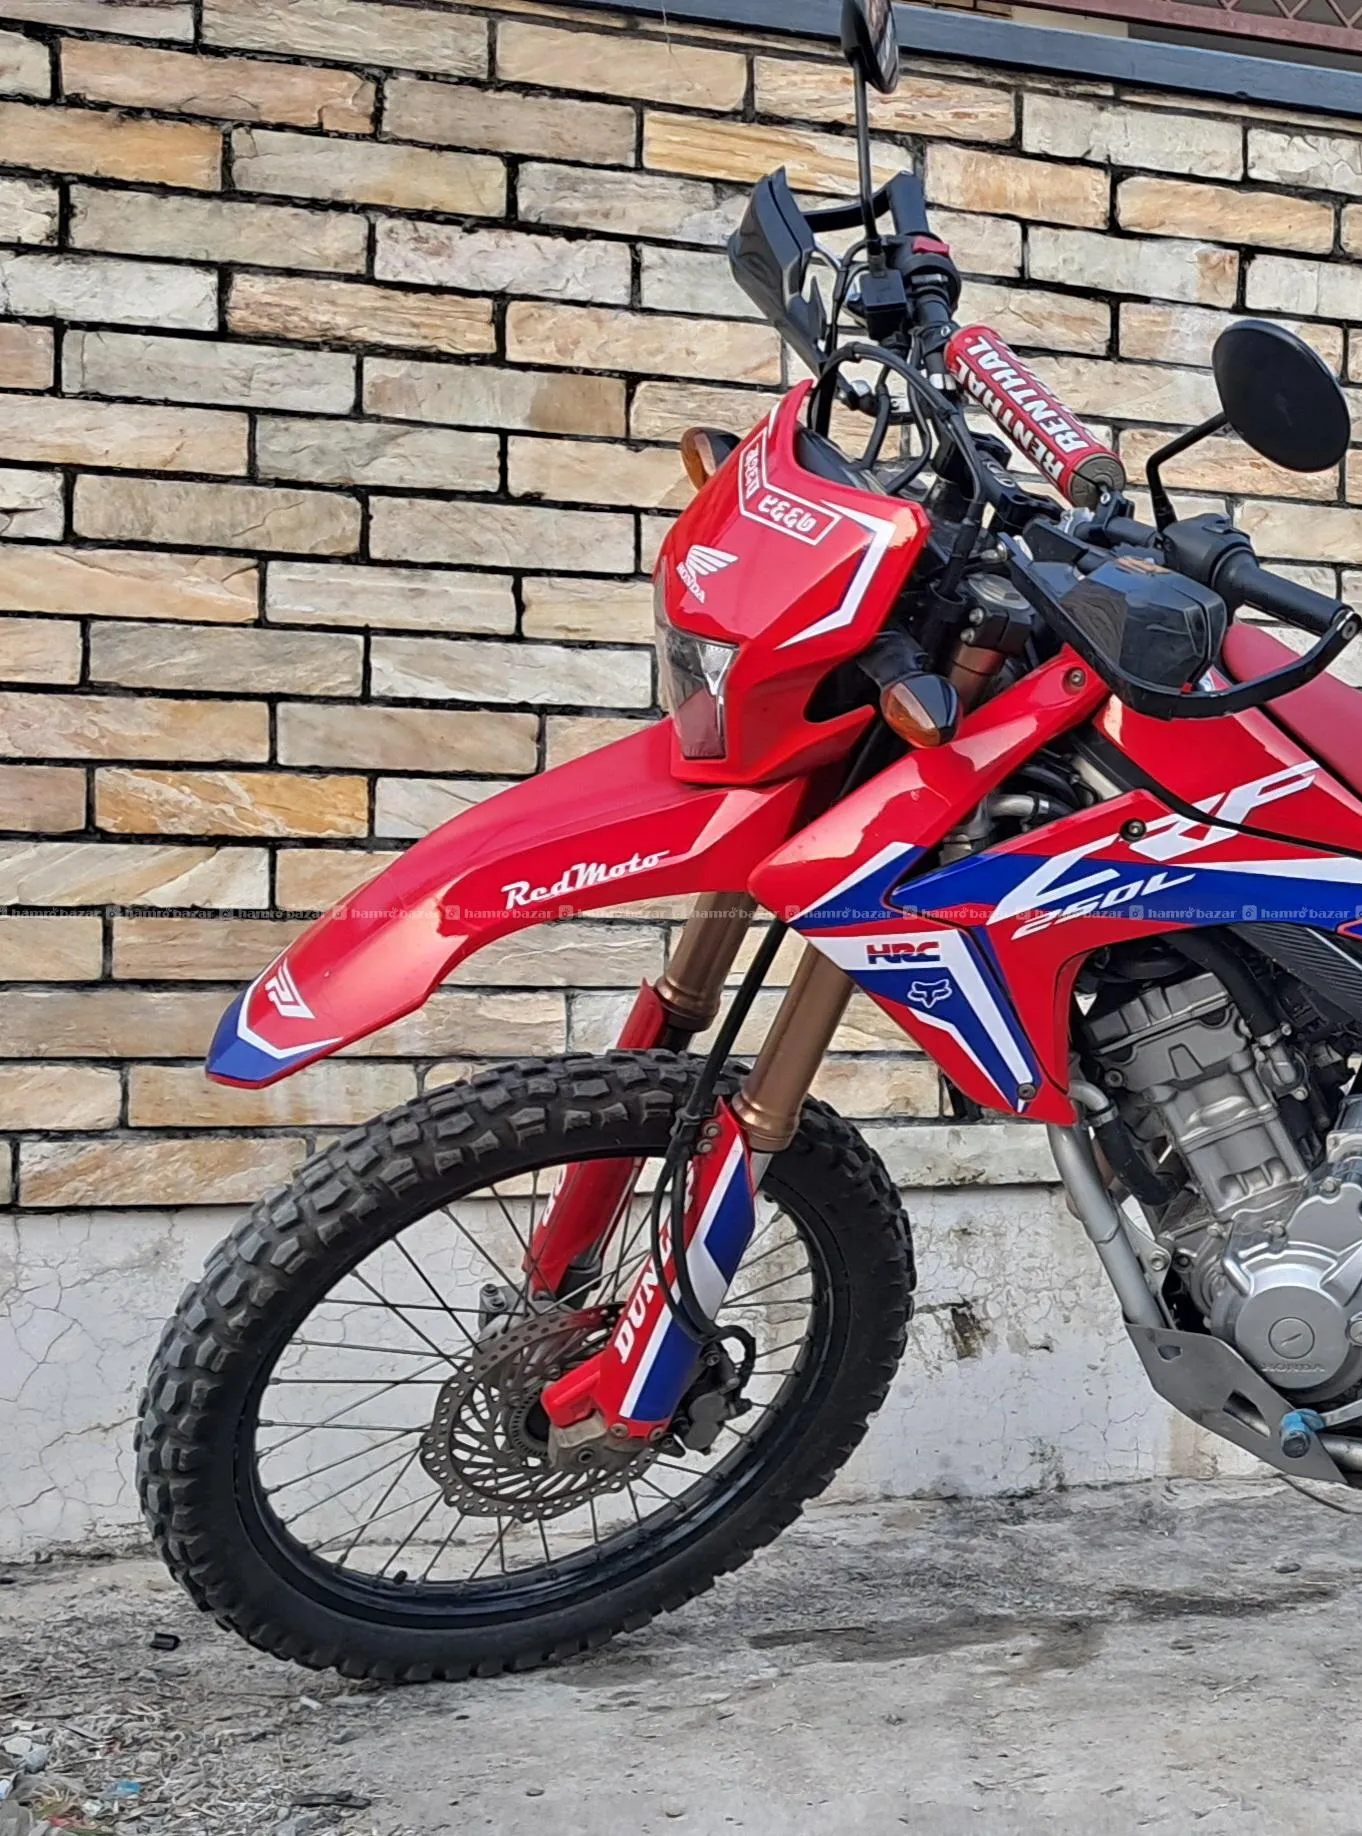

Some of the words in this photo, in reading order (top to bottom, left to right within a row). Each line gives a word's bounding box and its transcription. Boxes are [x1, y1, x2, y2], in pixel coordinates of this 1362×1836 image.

[956, 356, 1065, 481] RENTHAL
[967, 336, 1090, 453] RENTHAL
[676, 561, 705, 604] HONDA
[1011, 872, 1195, 940] 250L
[866, 941, 941, 965] HRC
